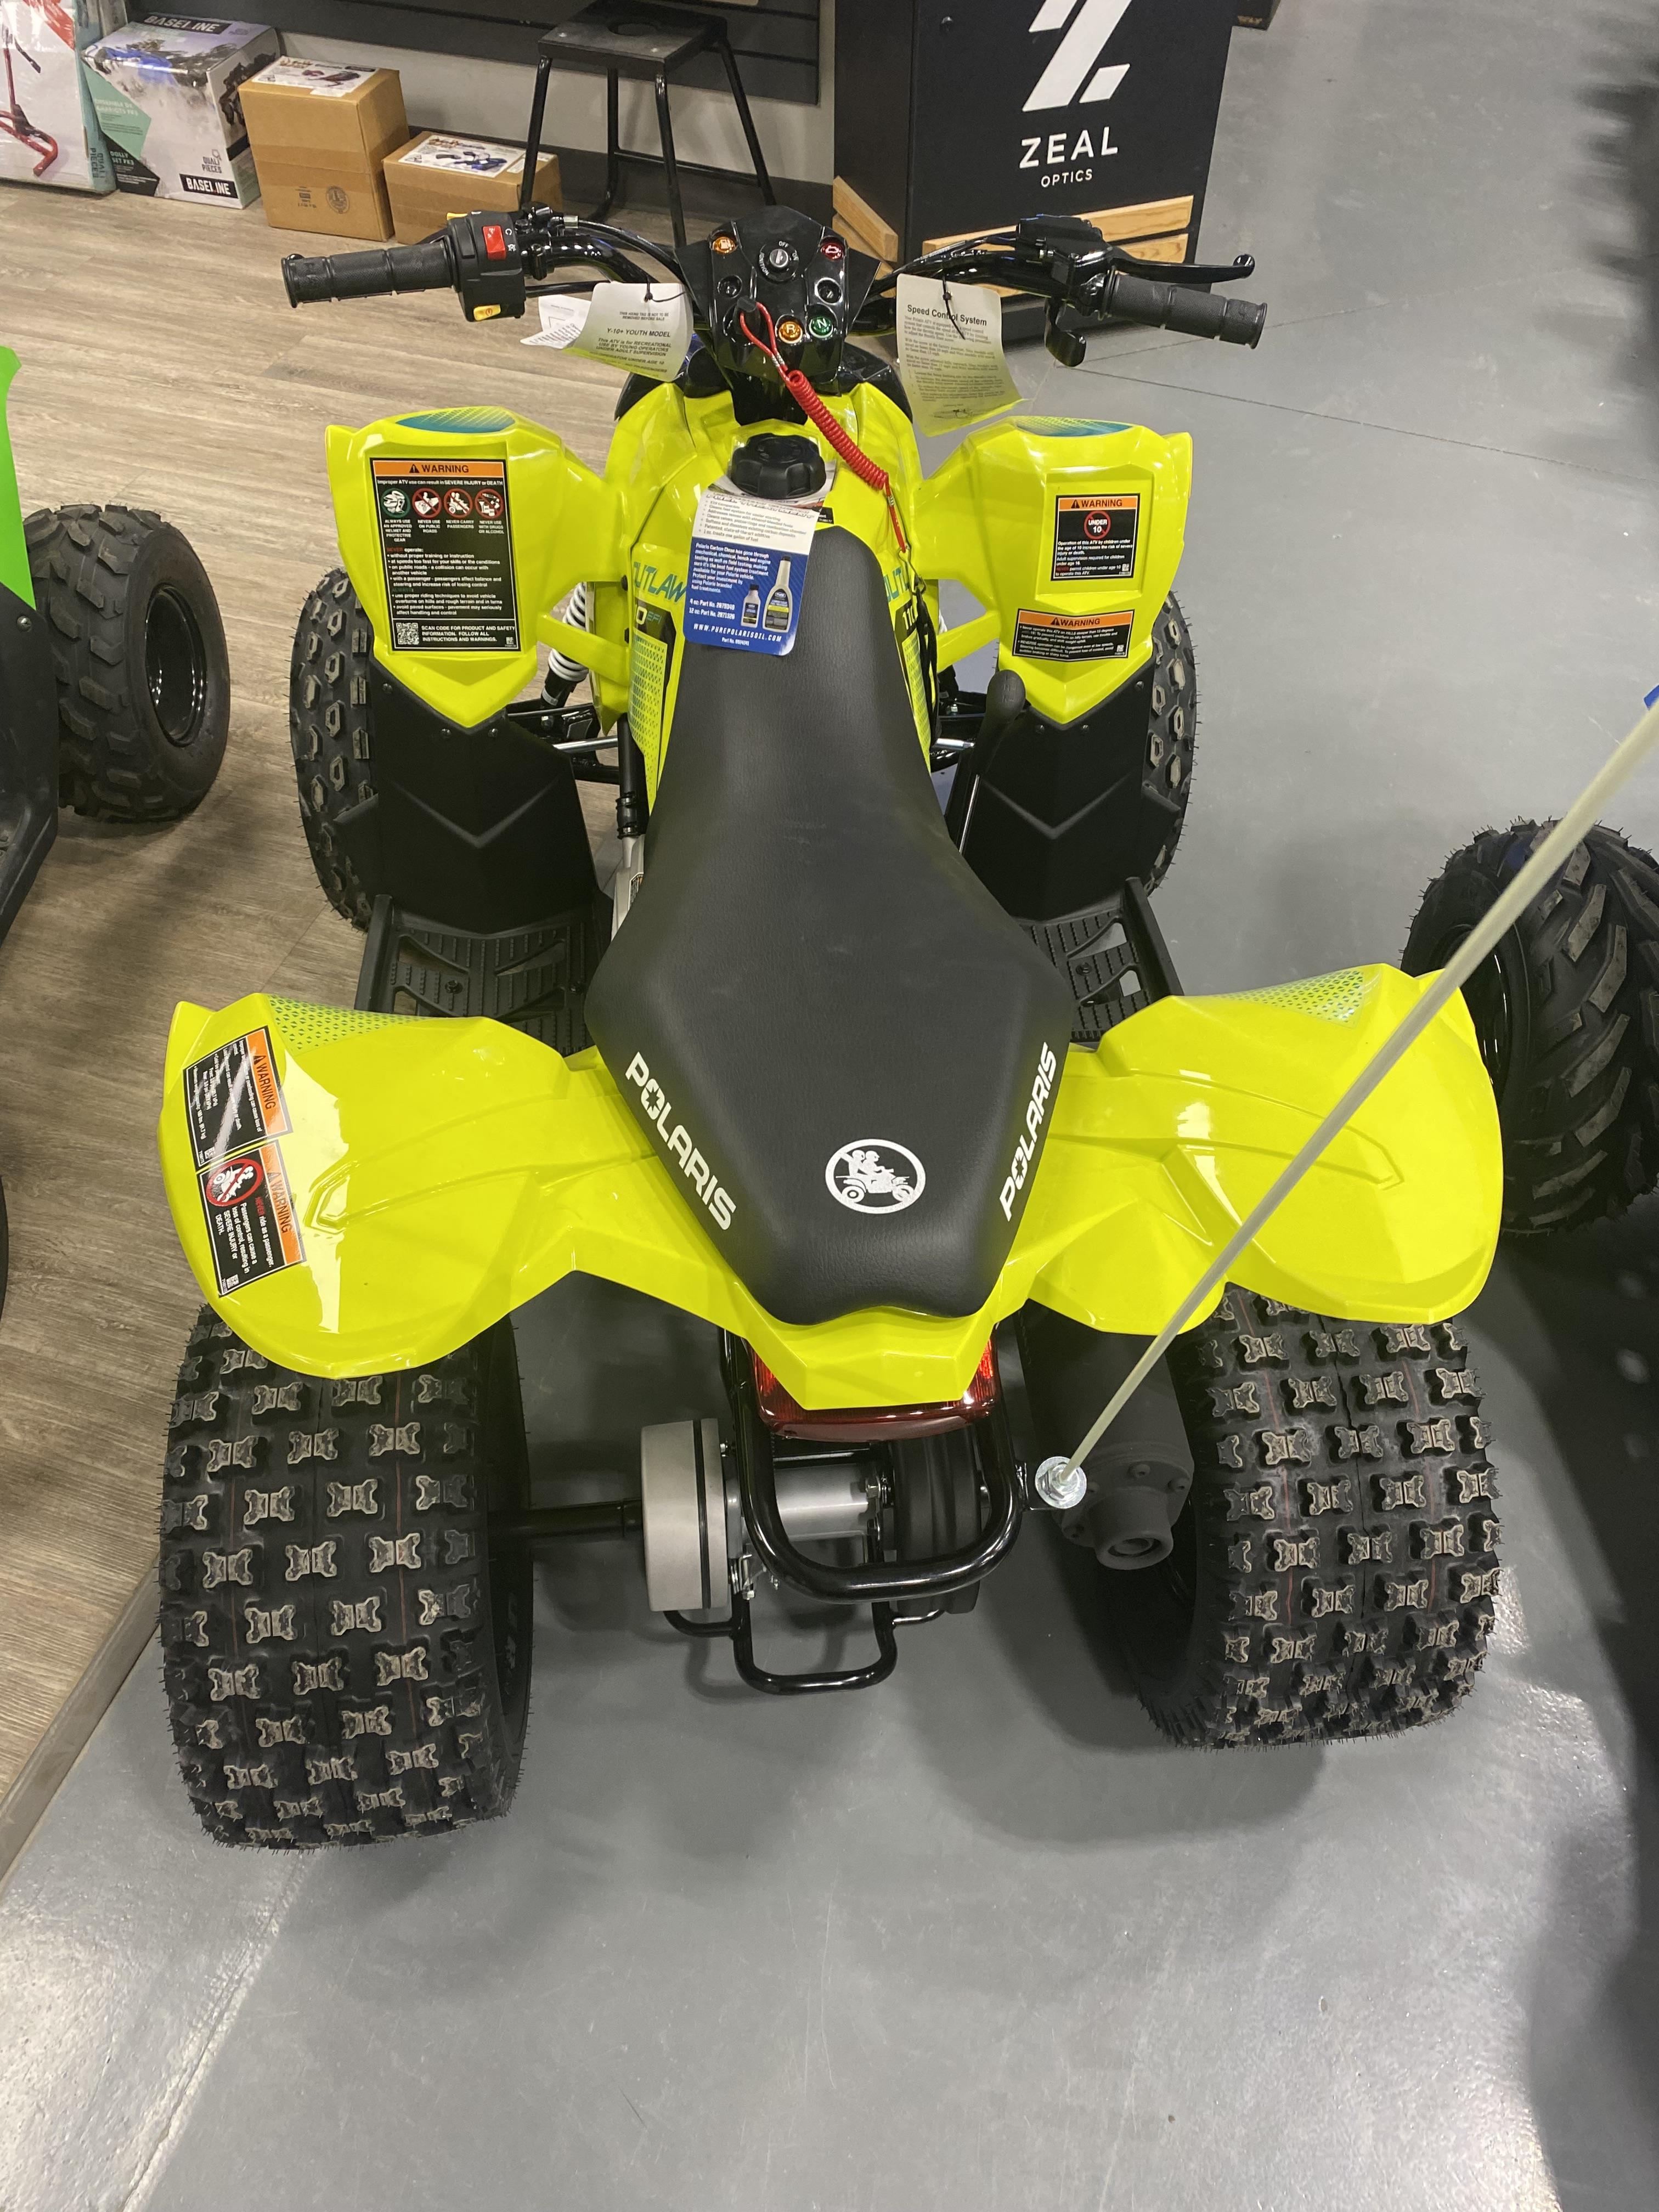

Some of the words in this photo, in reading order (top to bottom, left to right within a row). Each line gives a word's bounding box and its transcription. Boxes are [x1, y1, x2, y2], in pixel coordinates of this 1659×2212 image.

[144, 15, 220, 32] BASELINE
[1019, 126, 1118, 168] ZEAL
[202, 164, 222, 173] PIECES
[1041, 168, 1092, 187] OPTICS
[186, 178, 230, 195] BASELINE
[759, 252, 769, 275] IGNITION
[817, 318, 827, 329] N
[907, 304, 929, 315] Speed
[932, 309, 958, 321] Contol
[960, 314, 987, 326] System
[786, 324, 795, 333] R
[421, 465, 469, 473] WARNING
[1081, 499, 1122, 507] WARNING
[693, 623, 782, 642] WWW.PUREPOLARISOIL.COM
[1060, 618, 1101, 627] WARNING
[256, 1062, 276, 1110] WARNING
[625, 1051, 736, 1231] POLARIS
[999, 1041, 1057, 1222] POLARIS
[240, 1203, 251, 1233] Passengers
[270, 1183, 292, 1233] WARNING
[215, 1214, 224, 1235] DEATH.
[223, 1210, 233, 1232] SEVERE
[228, 1231, 238, 1252] INJURY
[235, 1224, 245, 1245] control,
[239, 1244, 249, 1268] resulting
[262, 1238, 274, 1267] passenger.
